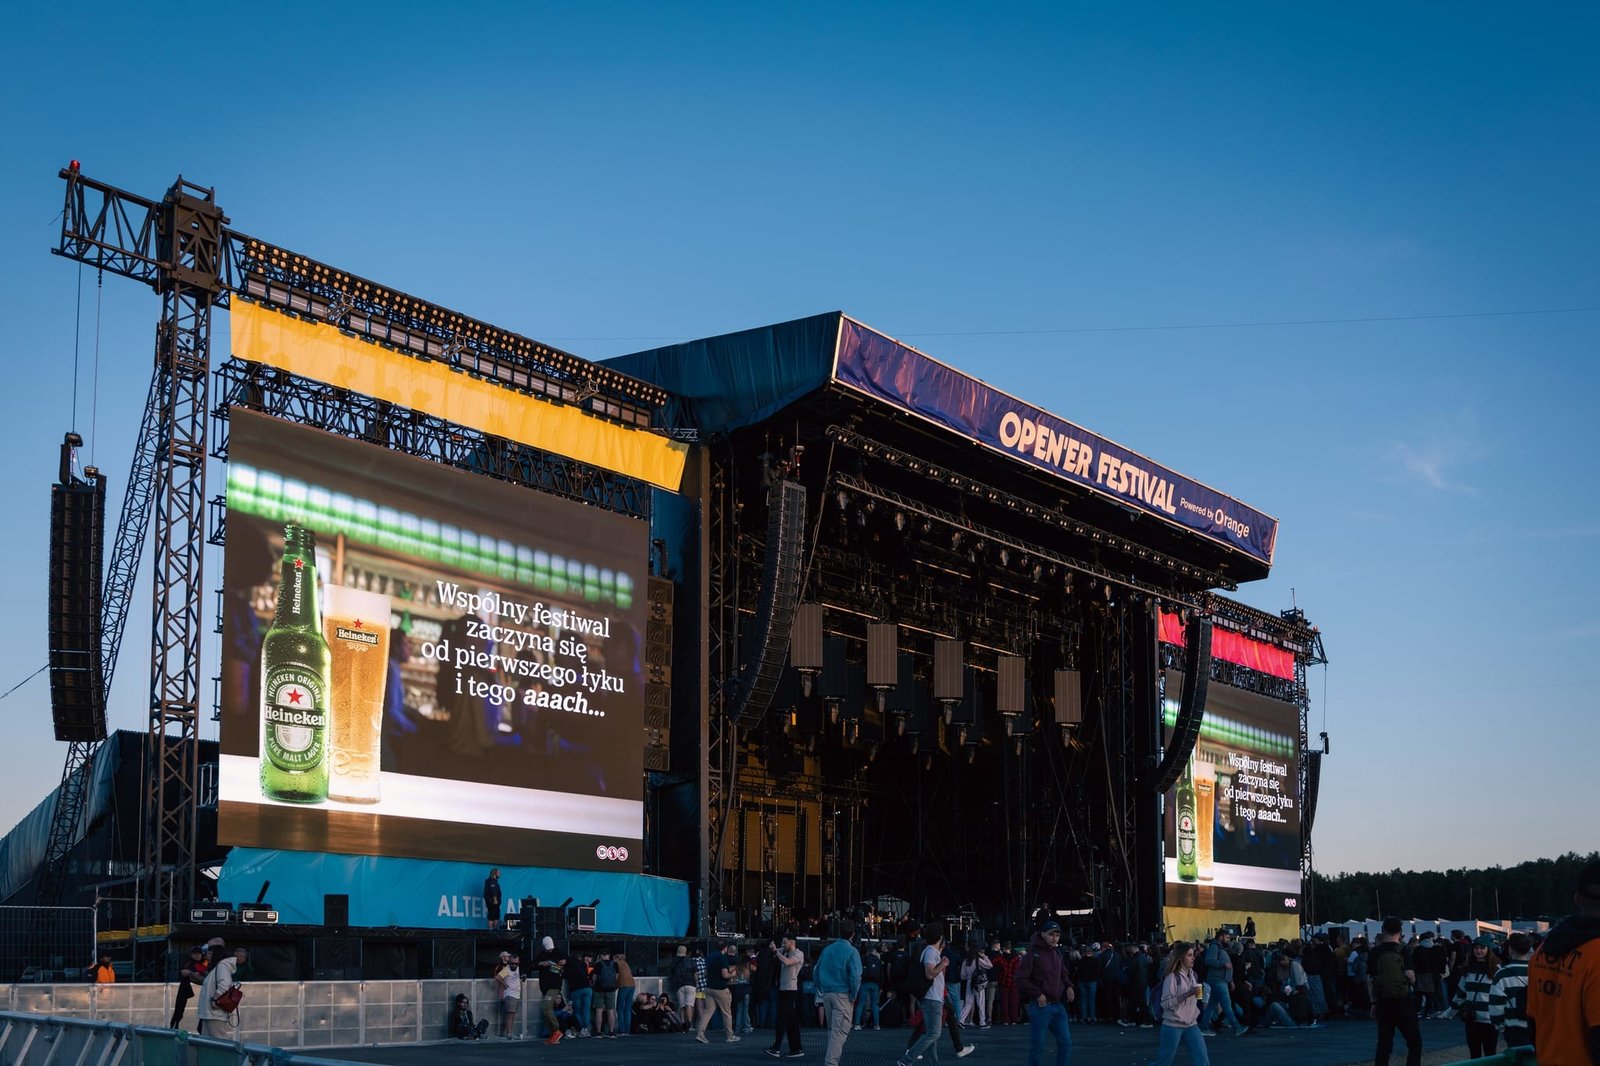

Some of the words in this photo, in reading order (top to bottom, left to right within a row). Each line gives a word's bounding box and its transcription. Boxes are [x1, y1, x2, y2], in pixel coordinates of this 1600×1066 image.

[1000, 412, 1093, 478] OPEN'ER
[1097, 452, 1176, 515] FESTIVAL
[1180, 497, 1207, 516] Powered
[1207, 508, 1214, 520] by
[1215, 509, 1250, 538] Orange
[292, 571, 302, 614] Heineken
[436, 579, 528, 624] Wspólny
[533, 603, 610, 638] festiwal
[338, 629, 377, 643] Heineken
[466, 621, 554, 653] zaczyna
[559, 637, 587, 663] się
[421, 639, 450, 662] od
[454, 646, 577, 687] pierwszego
[582, 666, 624, 693] łyku
[268, 673, 295, 697] HEINEKEN
[297, 675, 322, 703] ORIGINAL
[455, 673, 463, 694] i
[468, 675, 516, 705] tego
[523, 689, 605, 717] aaach...
[265, 705, 325, 726] Heineken
[269, 737, 282, 757] PURE
[282, 752, 301, 762] MALT
[304, 742, 320, 761] LAGER
[1229, 752, 1259, 773] Wspólny
[1260, 759, 1287, 776] festiwal
[1224, 785, 1234, 798] od
[1235, 787, 1276, 807] pierwszego
[1277, 794, 1293, 809] łyku
[1238, 774, 1268, 788] zaczyna
[1269, 777, 1280, 792] się
[1235, 804, 1239, 816] i
[1240, 805, 1256, 821] tego
